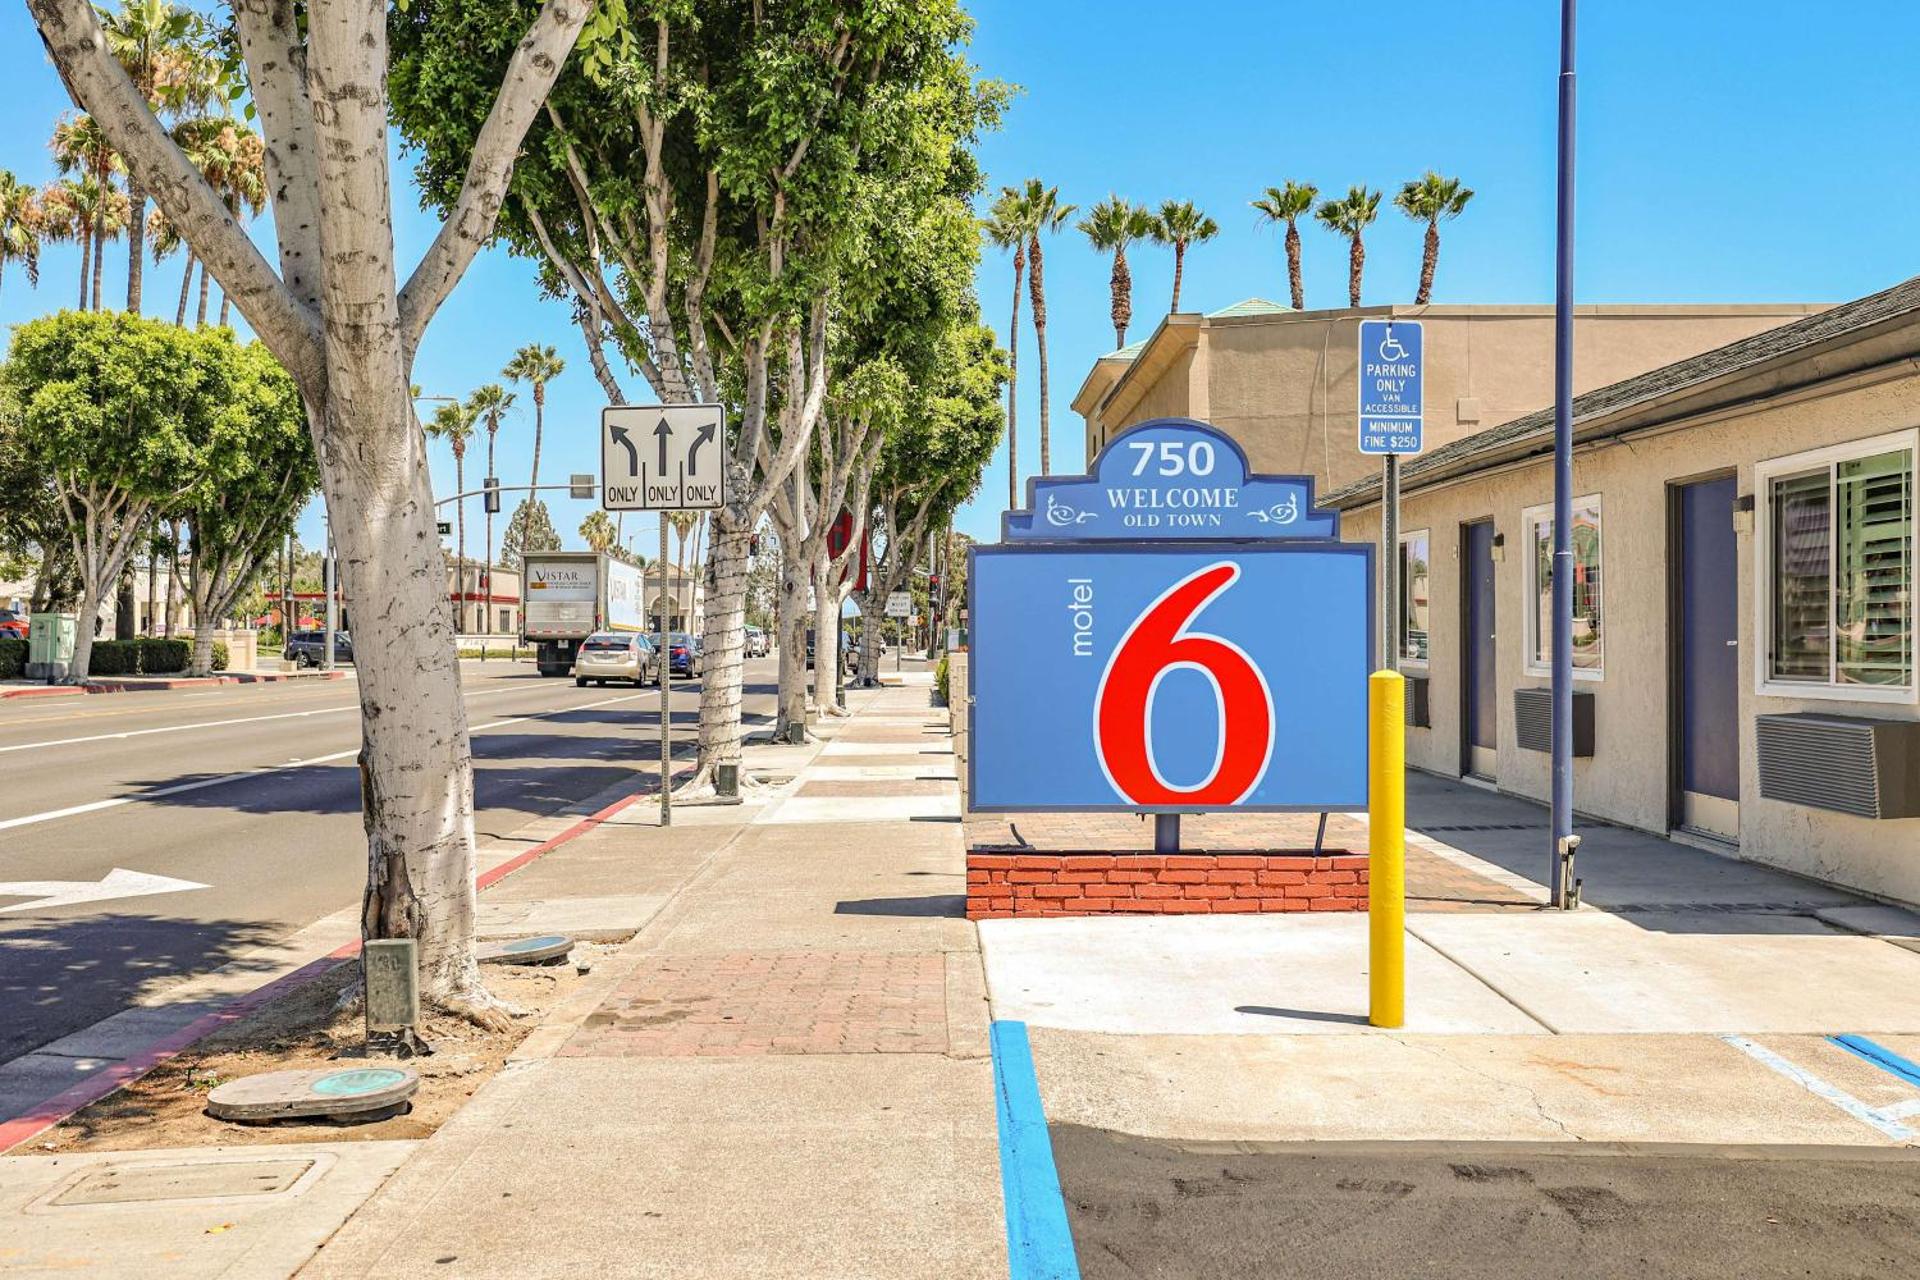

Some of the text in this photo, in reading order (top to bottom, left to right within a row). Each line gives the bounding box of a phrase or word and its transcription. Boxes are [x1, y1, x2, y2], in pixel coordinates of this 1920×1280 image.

[1366, 364, 1416, 377] PARKING
[1376, 379, 1405, 392] ONLY
[1382, 394, 1400, 402] VAN
[1365, 404, 1418, 413] ACCESSIBLE
[1369, 422, 1413, 433] MINIMUM
[1364, 436, 1418, 448] FINE $250
[1128, 441, 1216, 476] 750
[608, 485, 717, 502] ONLY ONLY ONLY
[1106, 488, 1239, 508] WELCOME
[1123, 514, 1221, 527] OLD TOWN
[535, 567, 579, 581] VISTAR
[1067, 578, 1093, 656] motel
[1093, 560, 1276, 805] 6
